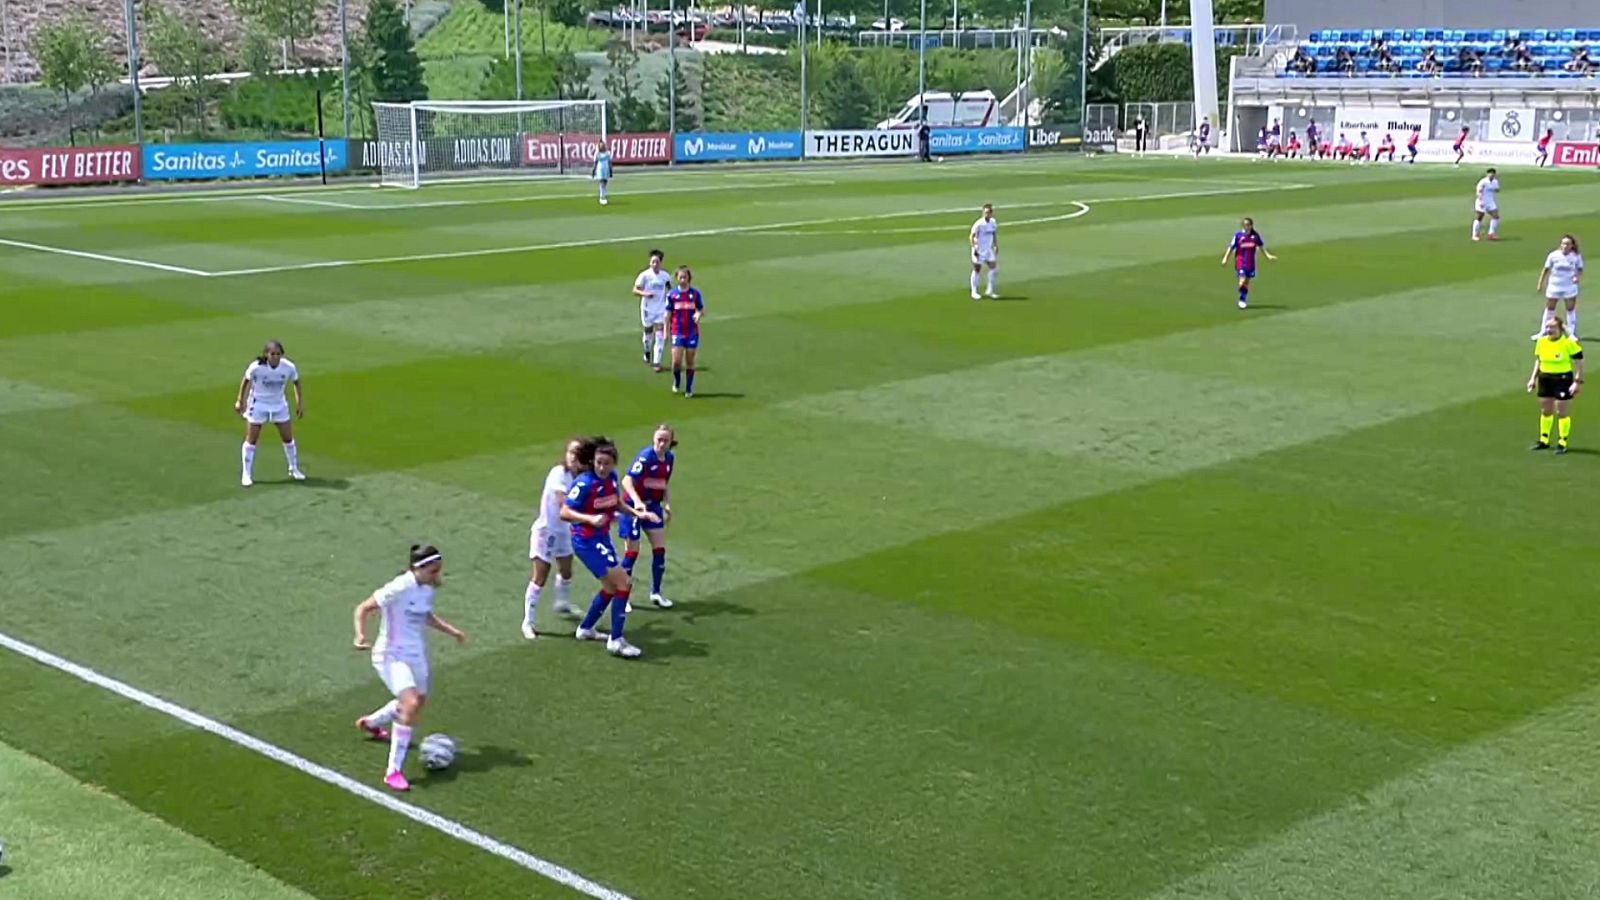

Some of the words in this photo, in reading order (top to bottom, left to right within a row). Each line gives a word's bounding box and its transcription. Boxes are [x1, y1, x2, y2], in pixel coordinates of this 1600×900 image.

[814, 133, 913, 153] THERAGUN
[977, 131, 1011, 146] Sanitas
[1029, 128, 1060, 146] Liber
[1083, 125, 1115, 144] bank
[362, 140, 426, 167] ADIDAS.CM
[454, 138, 511, 164] ADIDAS.COM
[527, 139, 600, 160] Emrate
[610, 138, 628, 159] FLY
[631, 137, 666, 159] BETTER
[1561, 146, 1600, 163] Emi
[0, 159, 31, 180] es
[41, 153, 69, 179] FLY
[74, 151, 132, 177] BETTER
[153, 151, 226, 172] Sanitas
[255, 149, 320, 168] Sanitas
